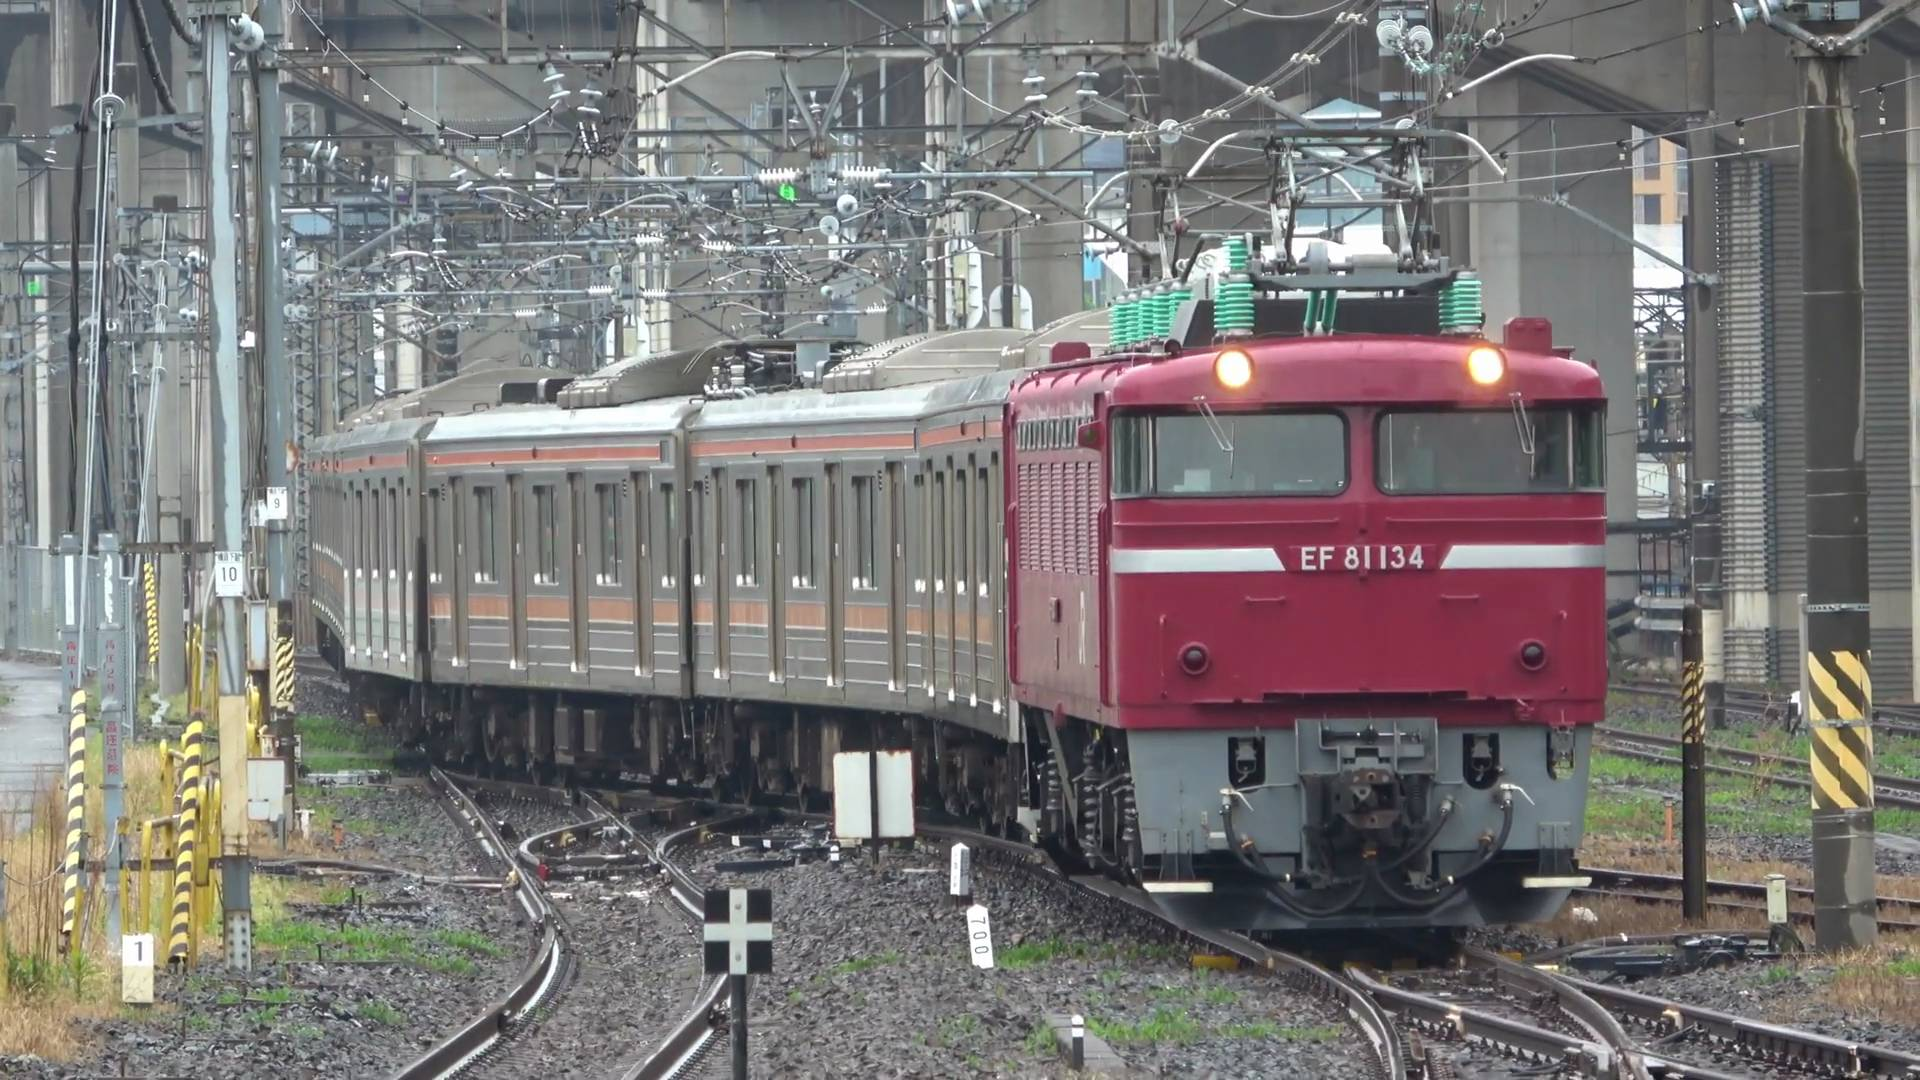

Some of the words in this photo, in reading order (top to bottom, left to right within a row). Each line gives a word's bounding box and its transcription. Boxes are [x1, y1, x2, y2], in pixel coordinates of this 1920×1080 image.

[274, 498, 280, 509] 9
[1301, 546, 1335, 571] EF
[222, 566, 238, 582] 10
[970, 916, 989, 954] 700
[134, 941, 143, 962] 1
